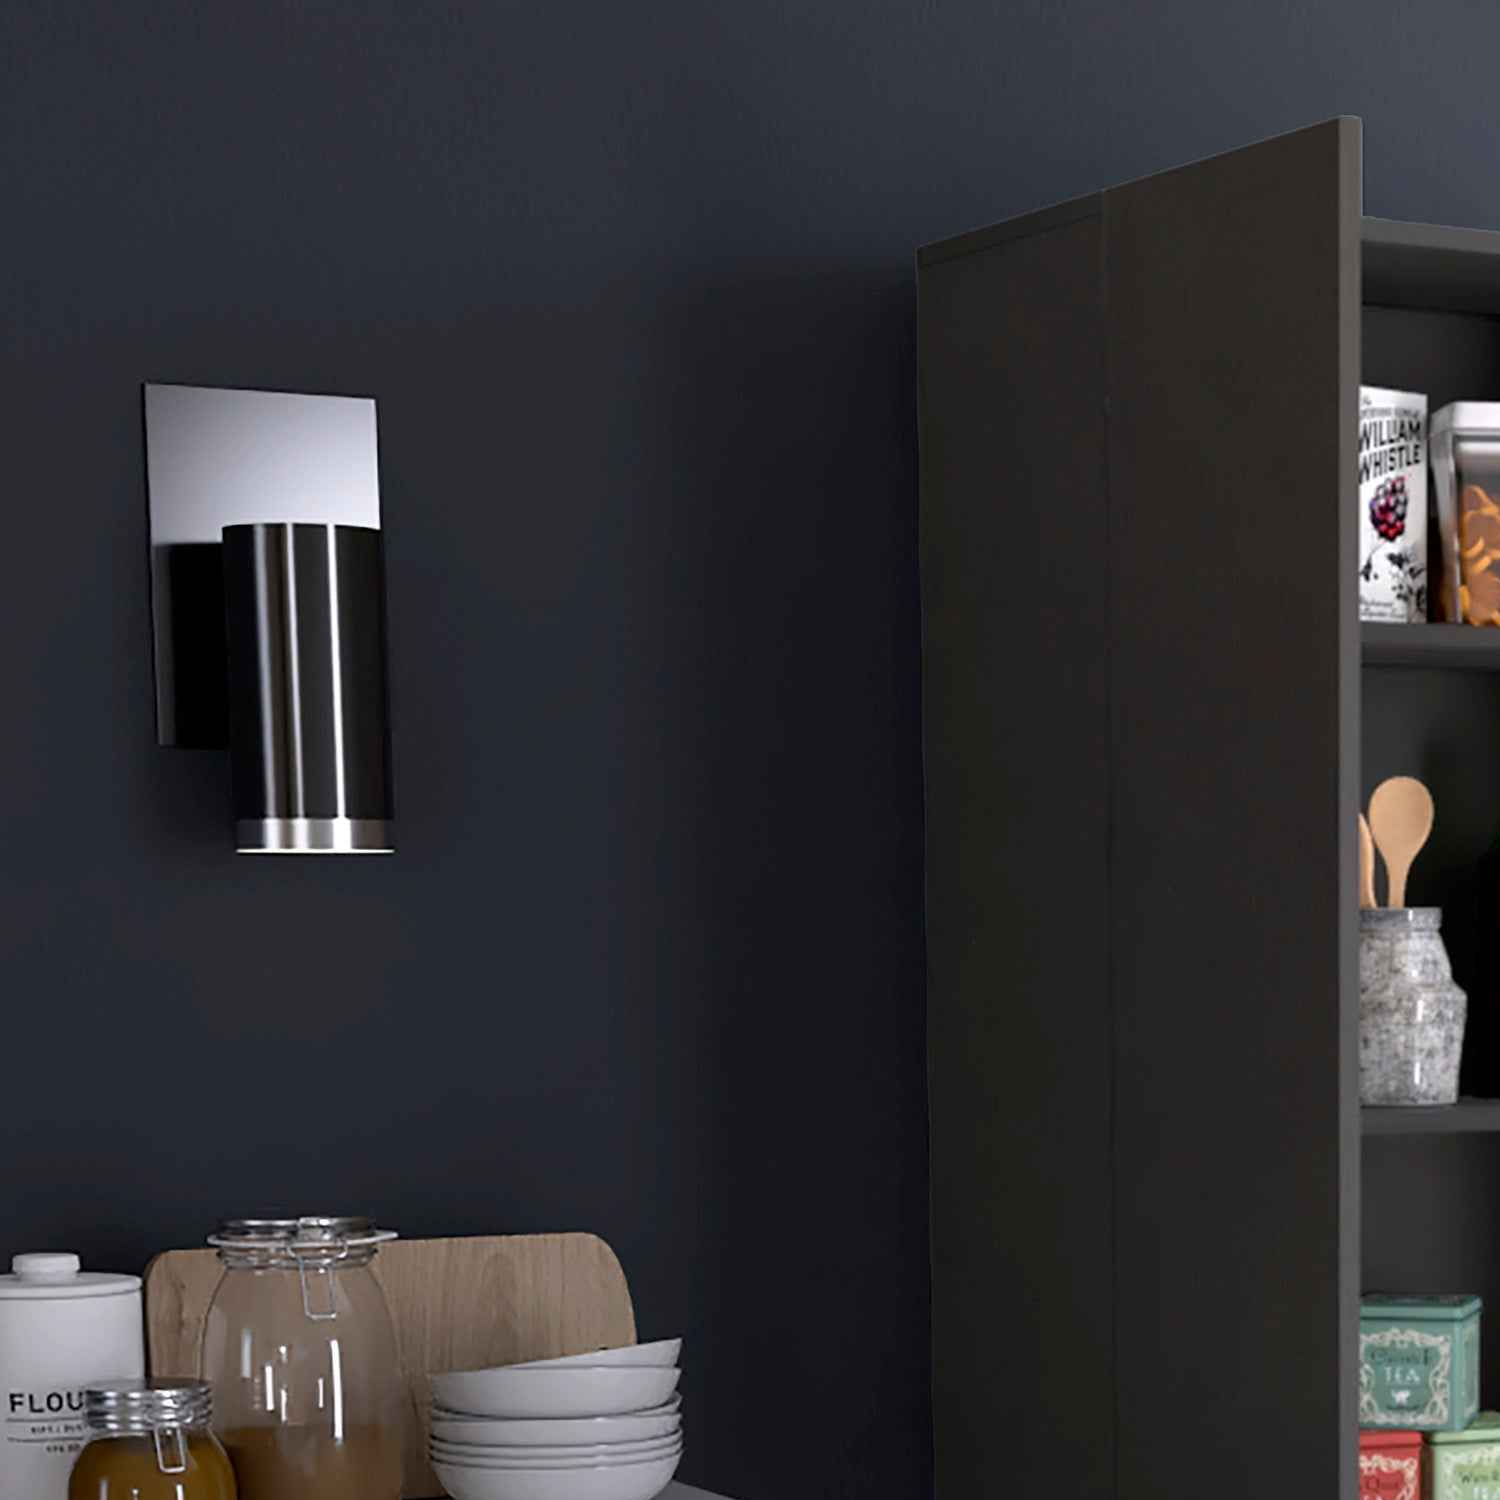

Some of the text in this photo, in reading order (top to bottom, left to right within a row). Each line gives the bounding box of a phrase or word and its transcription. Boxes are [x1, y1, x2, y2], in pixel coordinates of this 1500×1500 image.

[1359, 419, 1421, 453] WILLIAM
[1359, 444, 1421, 484] WHISTLE
[9, 1391, 84, 1413] FLOU
